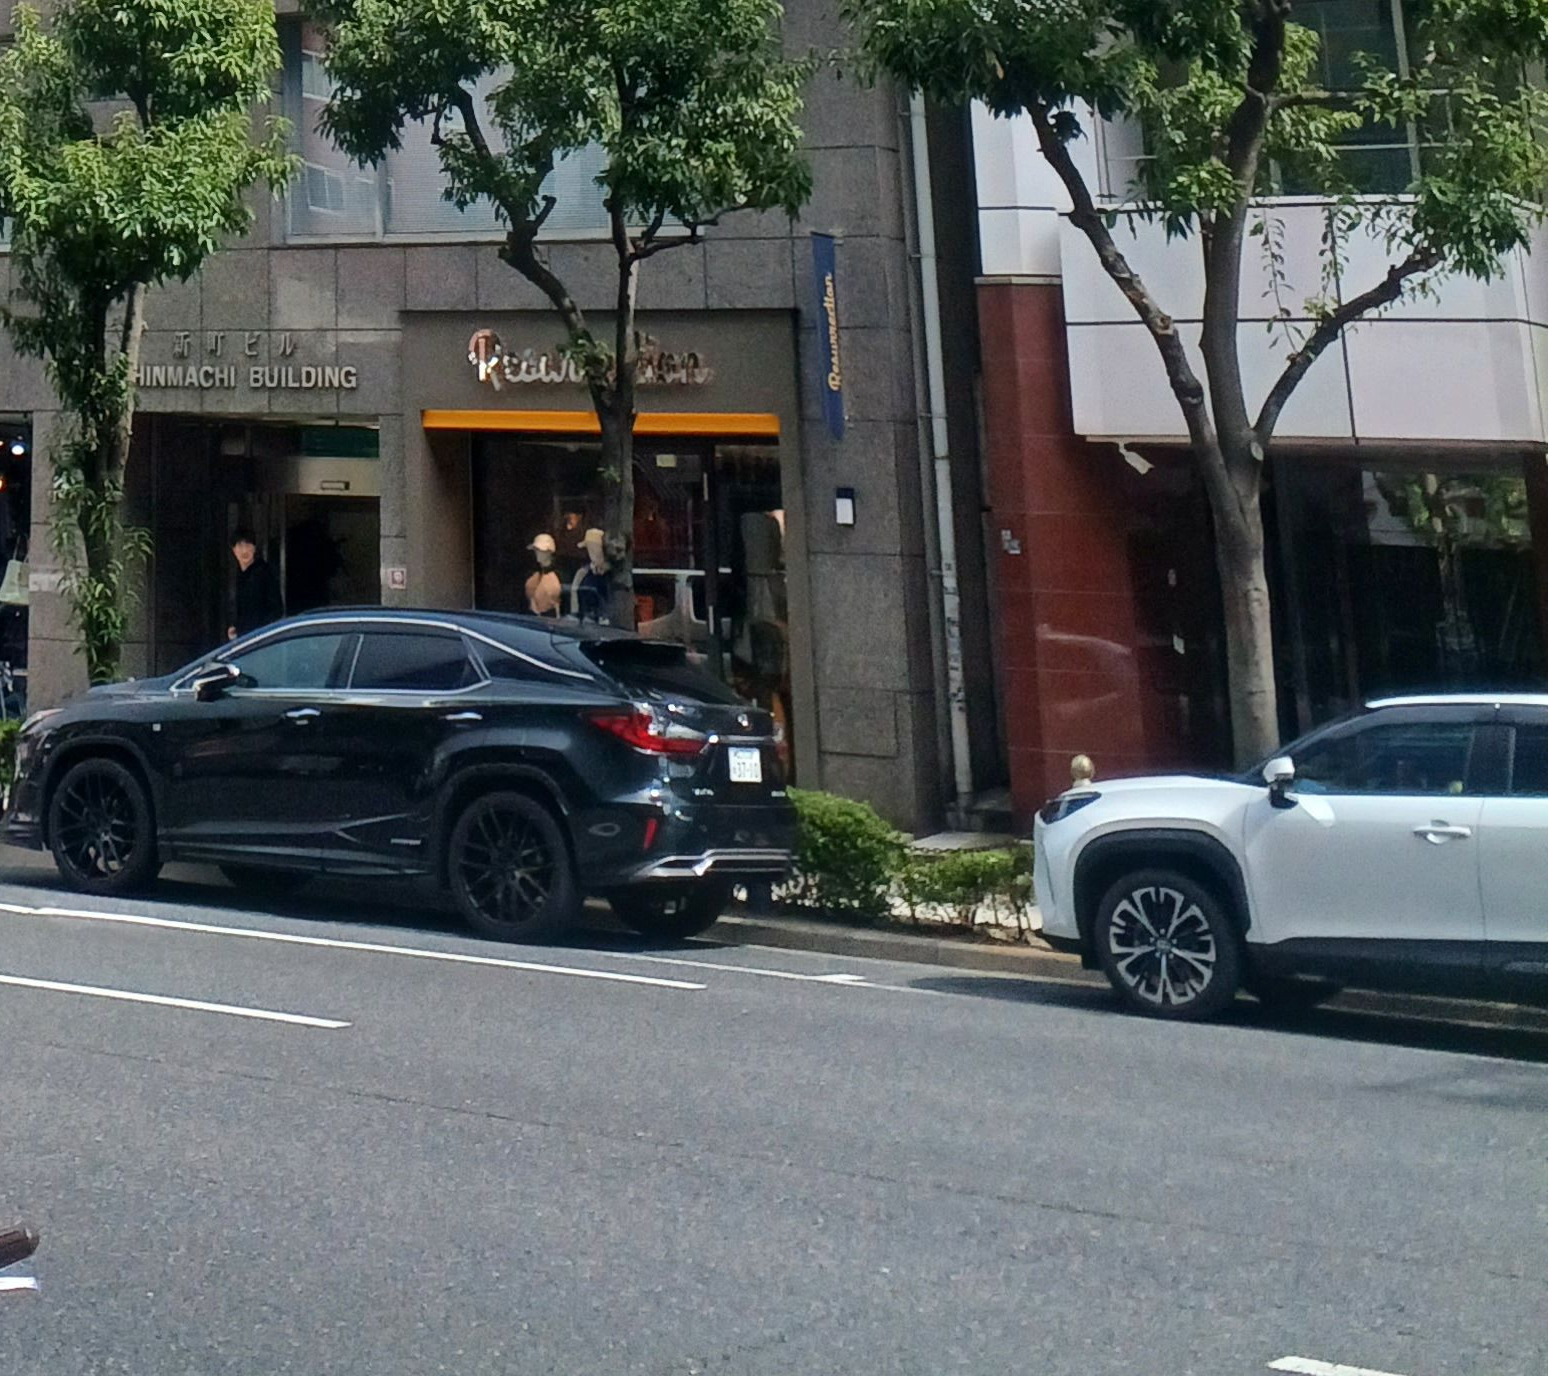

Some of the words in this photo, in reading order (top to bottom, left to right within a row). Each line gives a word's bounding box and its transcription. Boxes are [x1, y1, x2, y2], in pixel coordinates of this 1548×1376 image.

[173, 331, 297, 358] 新町ビル
[133, 364, 235, 388] HINMACHI
[249, 365, 357, 388] BUILDING
